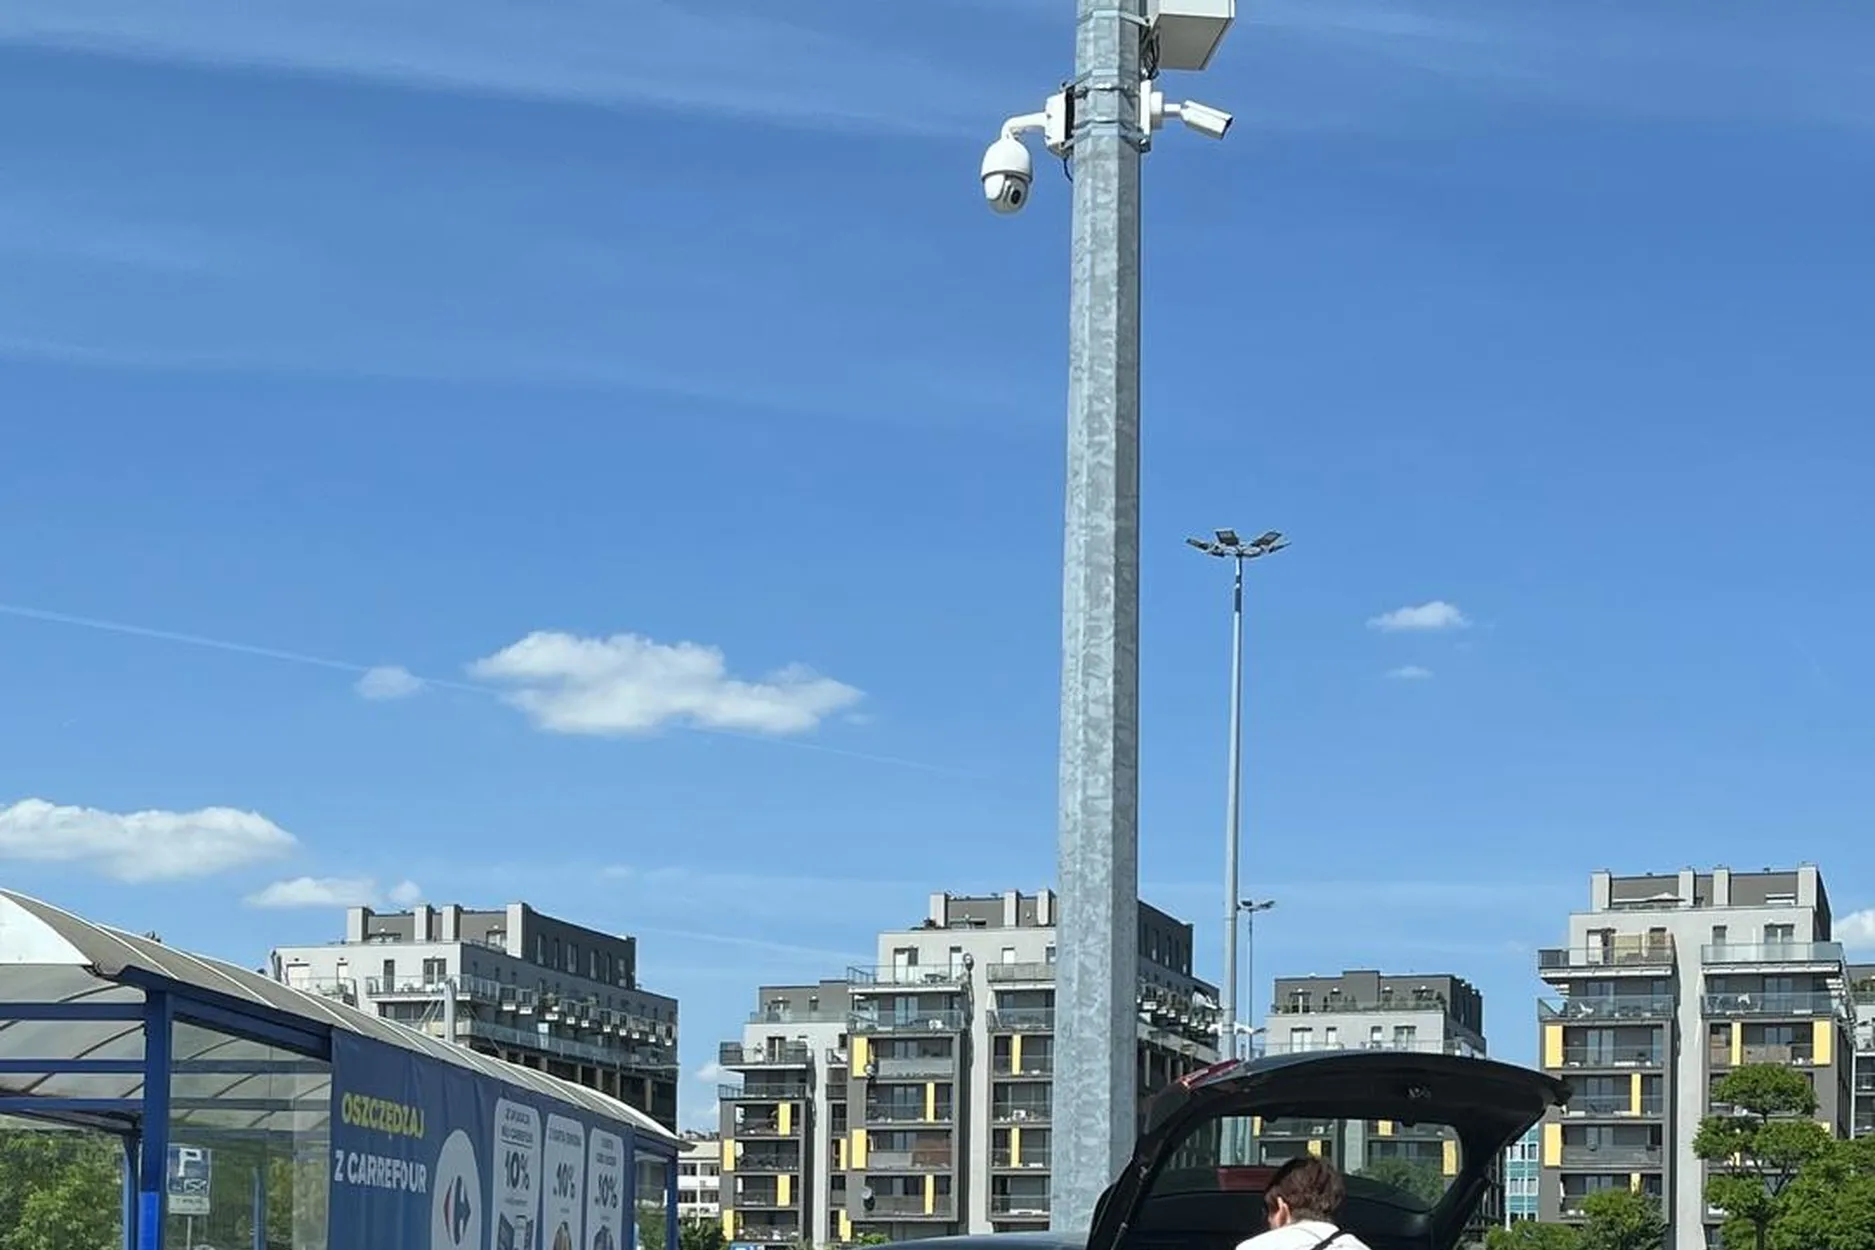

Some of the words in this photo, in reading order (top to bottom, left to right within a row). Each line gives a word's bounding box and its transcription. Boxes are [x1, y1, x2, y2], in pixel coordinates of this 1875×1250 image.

[341, 1092, 425, 1140] OSZCZĘDZAJ
[178, 1147, 202, 1177] P
[334, 1149, 345, 1182] Z
[347, 1152, 427, 1194] CARREFOUR
